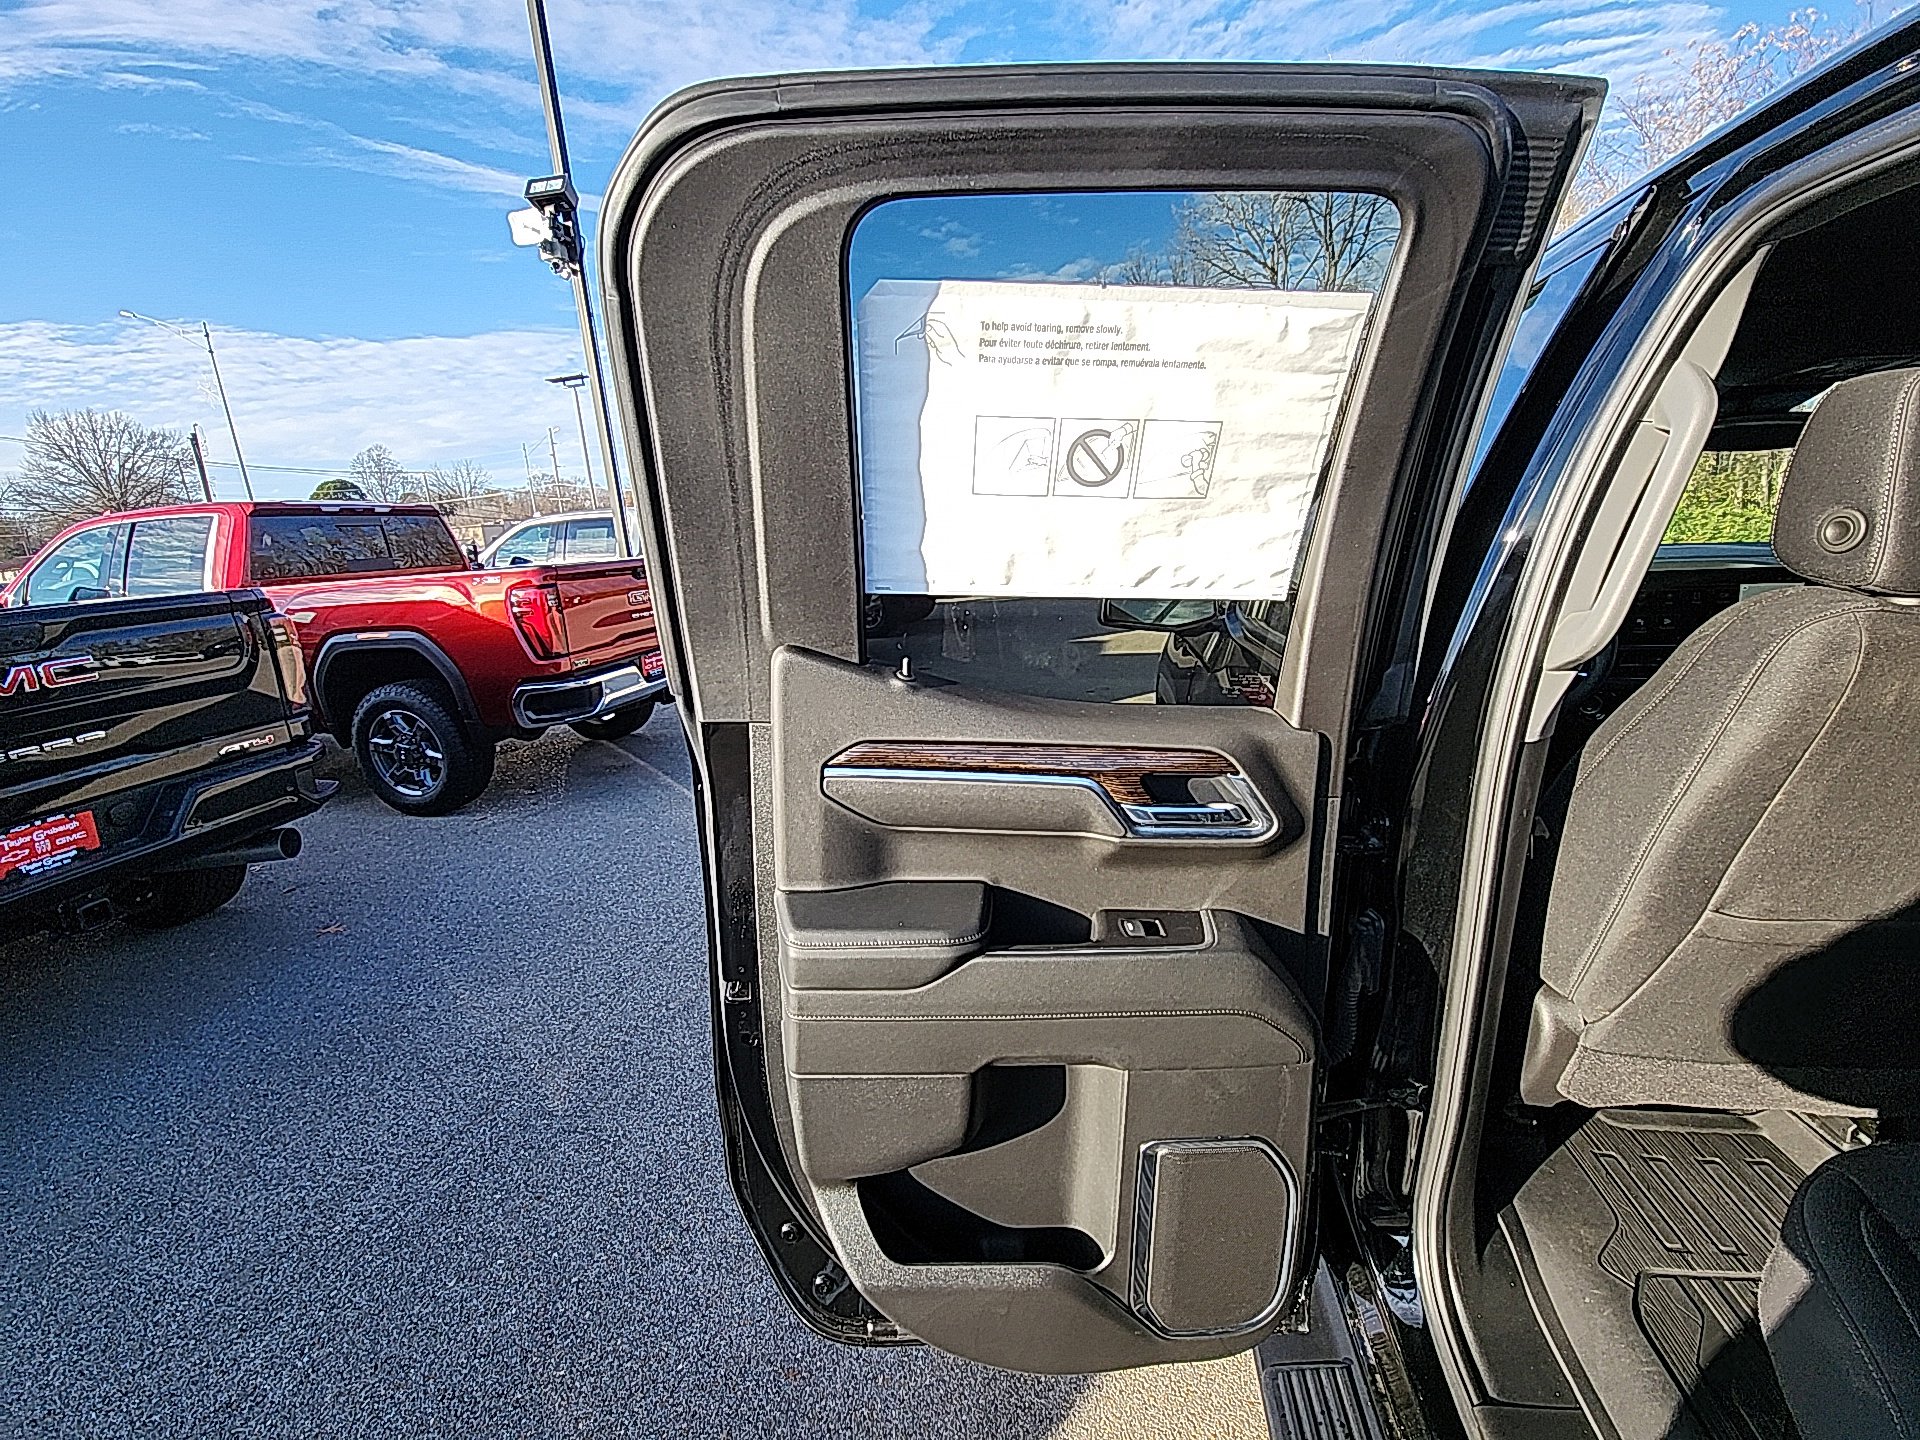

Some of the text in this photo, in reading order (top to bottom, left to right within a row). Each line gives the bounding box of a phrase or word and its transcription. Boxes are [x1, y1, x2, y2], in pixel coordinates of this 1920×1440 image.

[980, 321, 1123, 336] To help avoid tearing, remove slowly.
[979, 338, 997, 348] Pour
[999, 338, 1021, 348] éviter
[1023, 339, 1043, 349] toute
[1085, 341, 1109, 350] retirer
[1111, 341, 1151, 352] lentement.
[979, 354, 1207, 370] Para ayudarse a evitar que se rompa, remuévala lentamente.
[0, 731, 106, 763] RRA
[32, 820, 80, 841] Grubaugh
[55, 830, 88, 846] GMC
